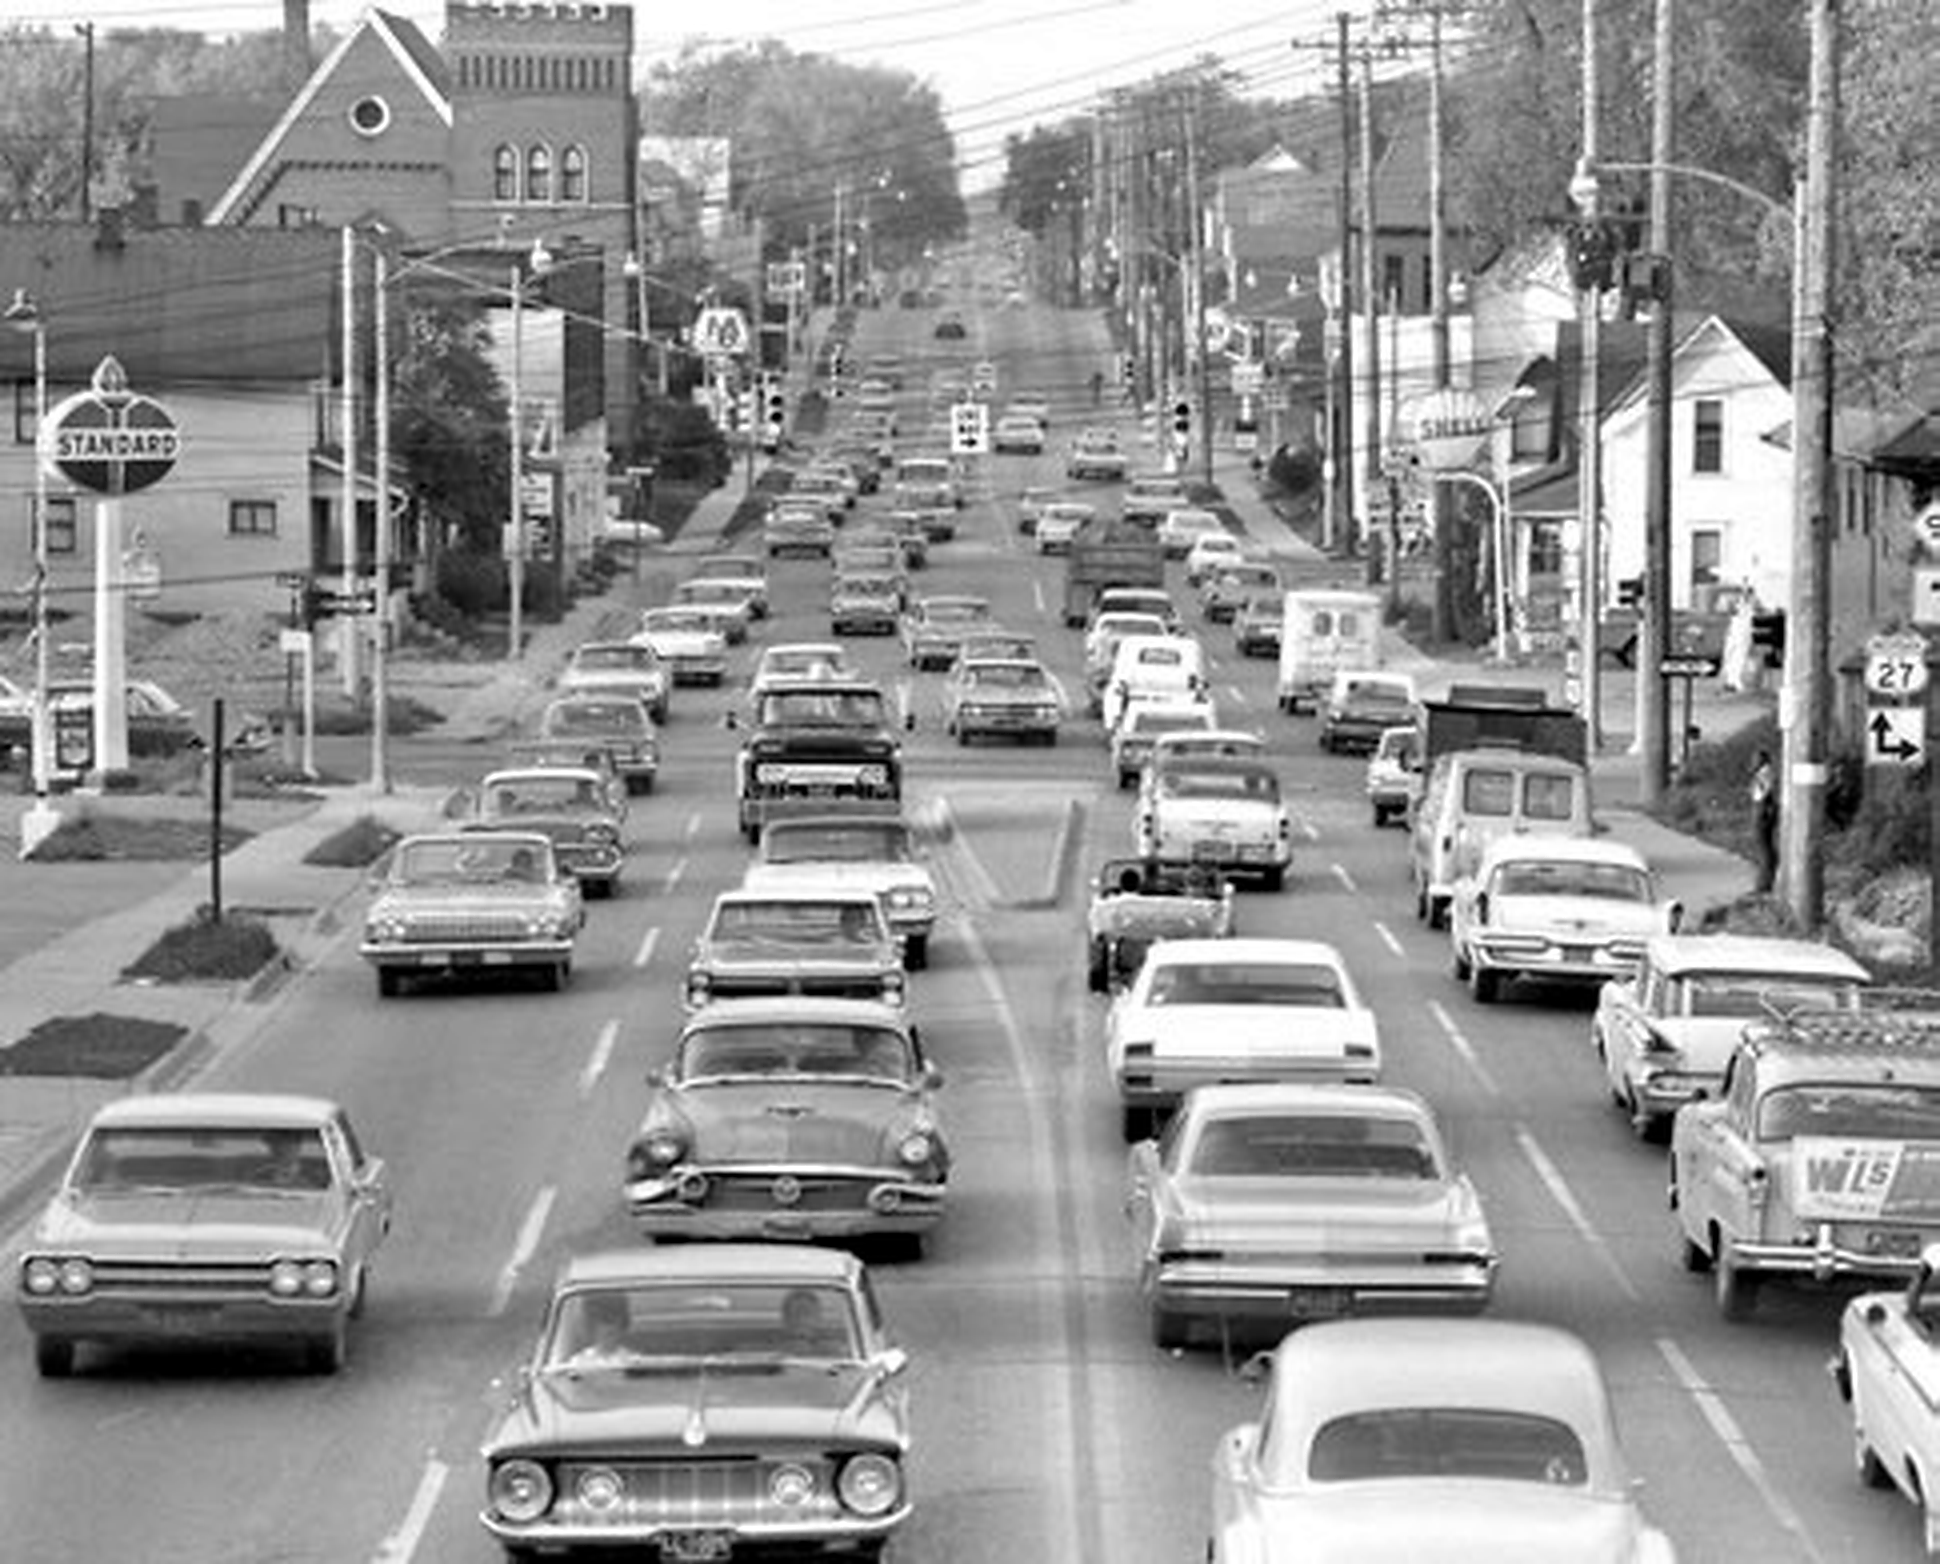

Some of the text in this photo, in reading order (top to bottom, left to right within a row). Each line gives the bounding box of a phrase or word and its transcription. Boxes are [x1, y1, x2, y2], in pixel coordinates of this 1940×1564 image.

[1420, 417, 1491, 440] SHELL
[59, 434, 177, 456] STANDARD
[1879, 662, 1913, 689] 27
